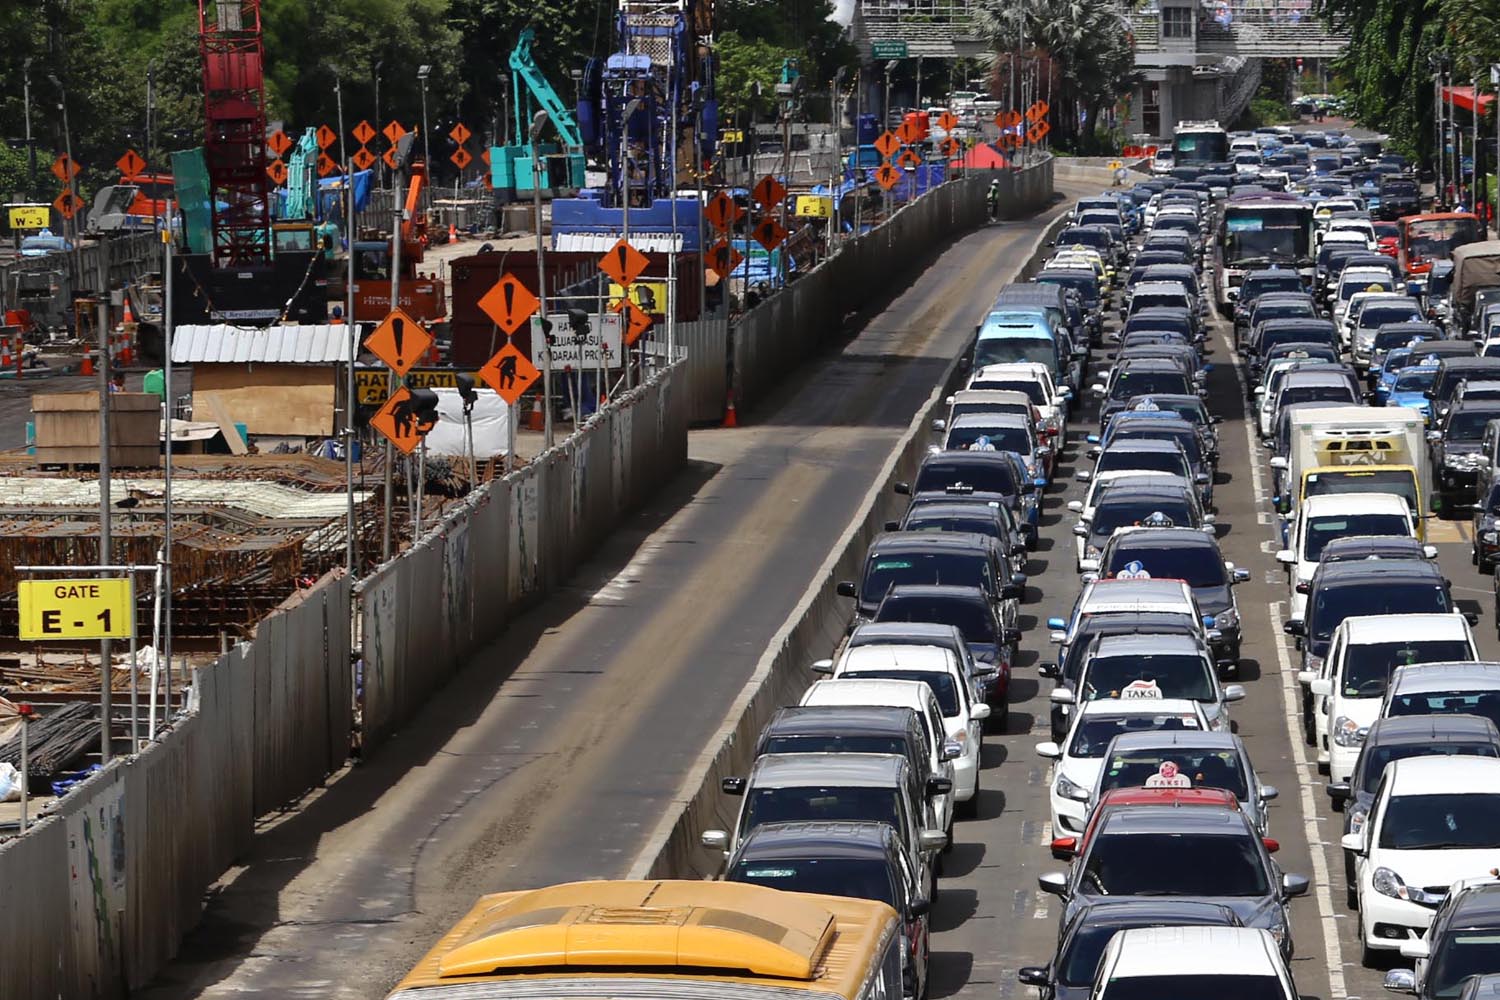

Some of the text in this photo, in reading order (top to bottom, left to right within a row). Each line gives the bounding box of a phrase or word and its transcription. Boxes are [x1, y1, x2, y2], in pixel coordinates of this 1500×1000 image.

[55, 585, 99, 598] GATE
[42, 610, 61, 633] E
[97, 609, 111, 632] 1
[1126, 690, 1157, 698] TAKSI
